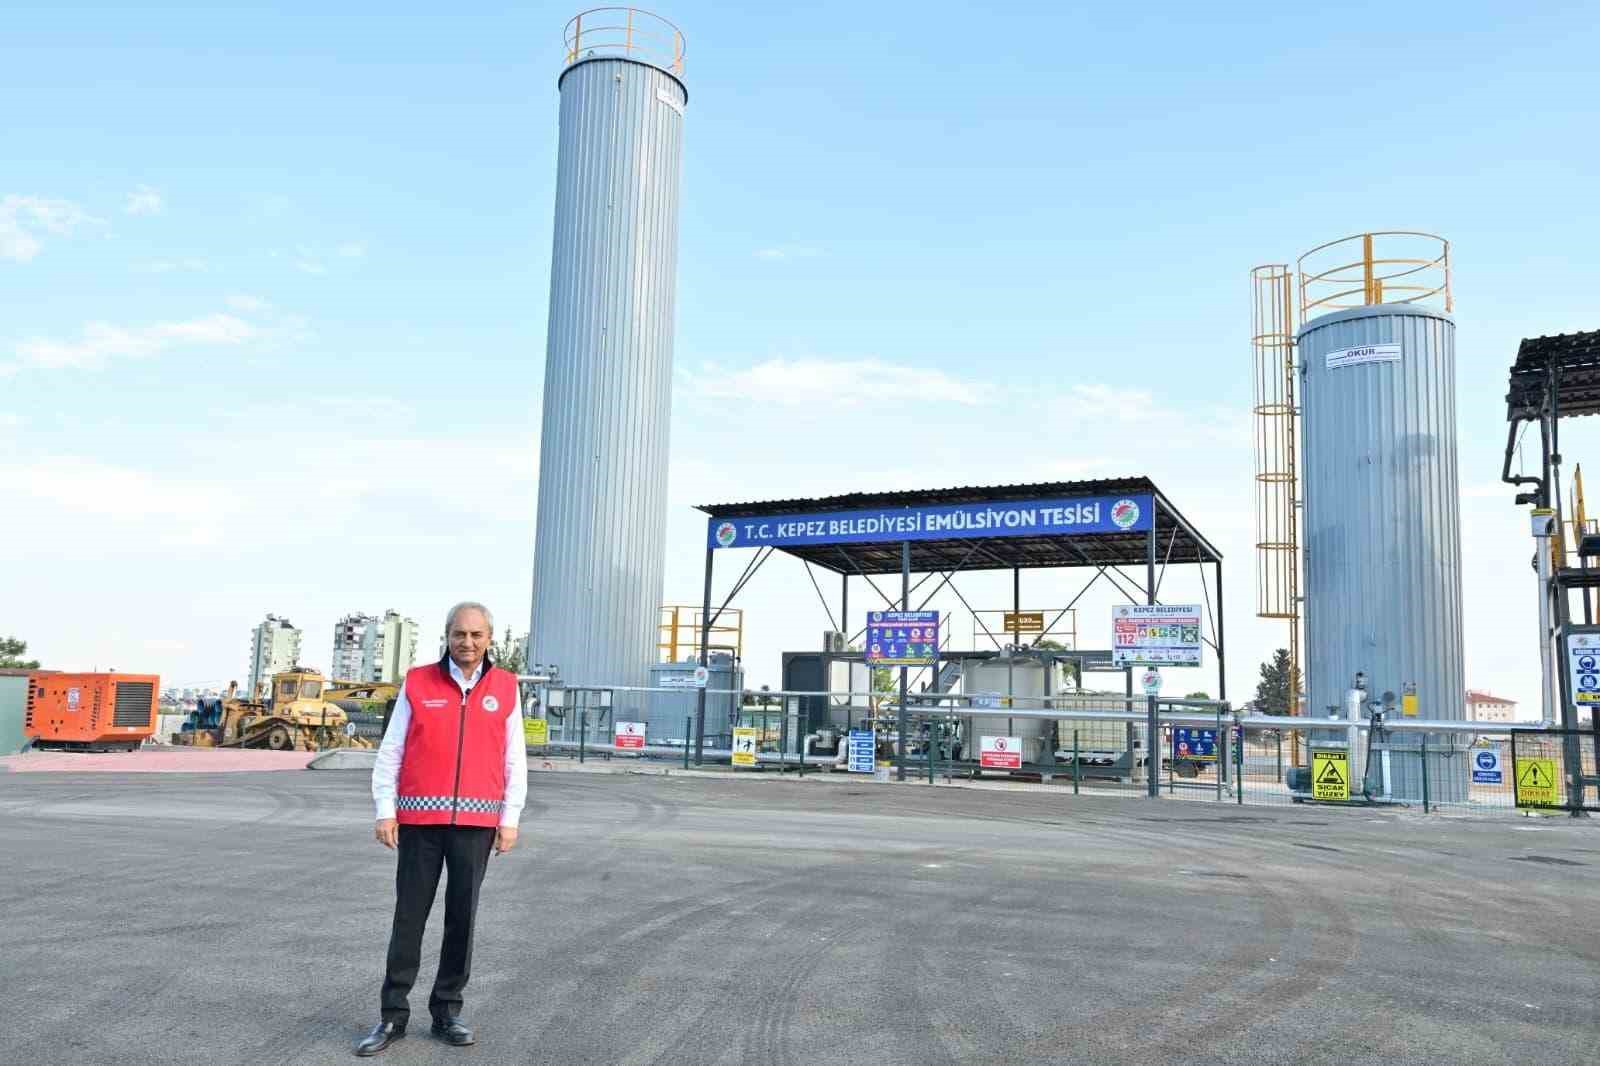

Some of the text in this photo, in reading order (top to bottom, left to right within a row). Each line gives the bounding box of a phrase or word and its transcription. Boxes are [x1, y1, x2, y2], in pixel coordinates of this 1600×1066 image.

[1346, 348, 1376, 358] OKUR
[744, 501, 1100, 540] T.C. KEPEZ BELEDİYESİ EMÜLSİYON TESİSİ
[1118, 633, 1135, 644] 112
